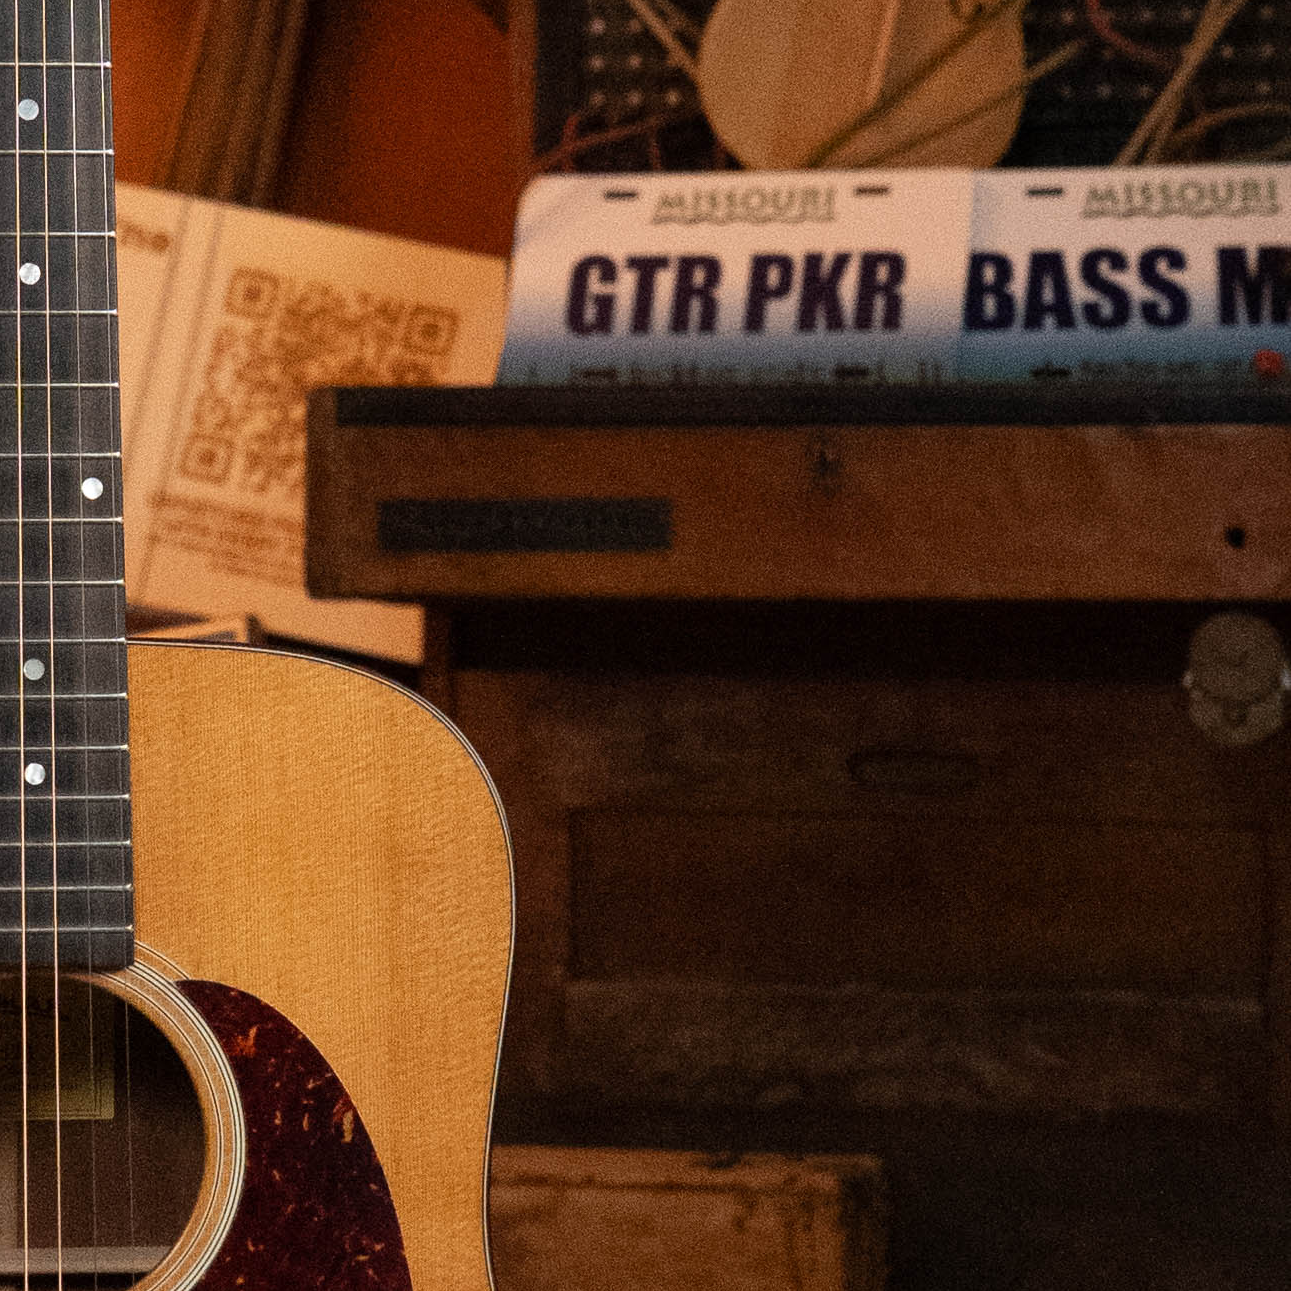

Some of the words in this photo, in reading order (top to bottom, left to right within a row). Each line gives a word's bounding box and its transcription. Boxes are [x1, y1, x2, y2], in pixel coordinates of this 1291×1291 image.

[651, 186, 836, 223] MISSOURI
[1081, 177, 1279, 217] MISSOURI
[564, 251, 723, 337] GTR
[744, 249, 908, 335] PKR
[963, 247, 1192, 332] BASS
